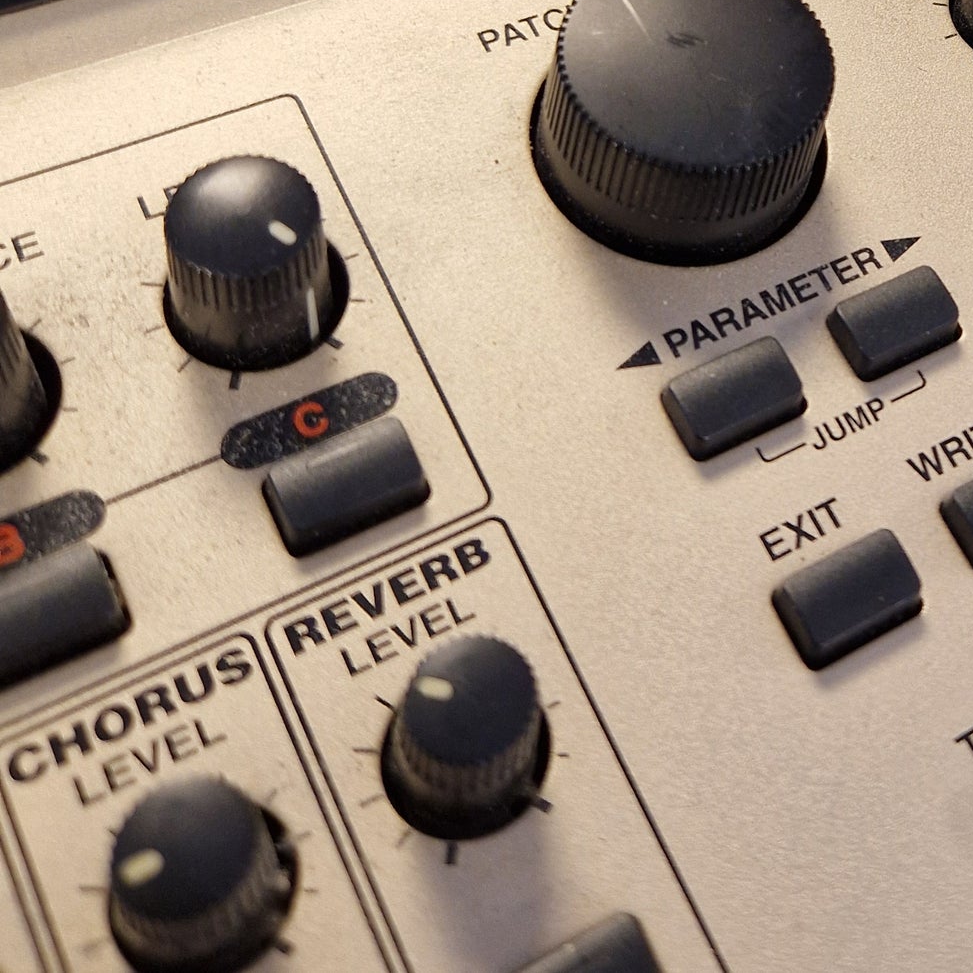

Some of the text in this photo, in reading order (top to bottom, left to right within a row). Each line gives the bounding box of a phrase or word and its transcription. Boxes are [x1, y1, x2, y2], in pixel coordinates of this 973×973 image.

[477, 8, 565, 53] PATC
[662, 246, 883, 359] PARAMETER
[292, 400, 330, 438] C
[812, 397, 885, 451] JUMP
[758, 498, 844, 561] EXIT
[283, 538, 492, 655] REVERB
[340, 597, 476, 677] LEVEL
[5, 647, 254, 784] CHORUS
[72, 719, 227, 807] LEVEL
